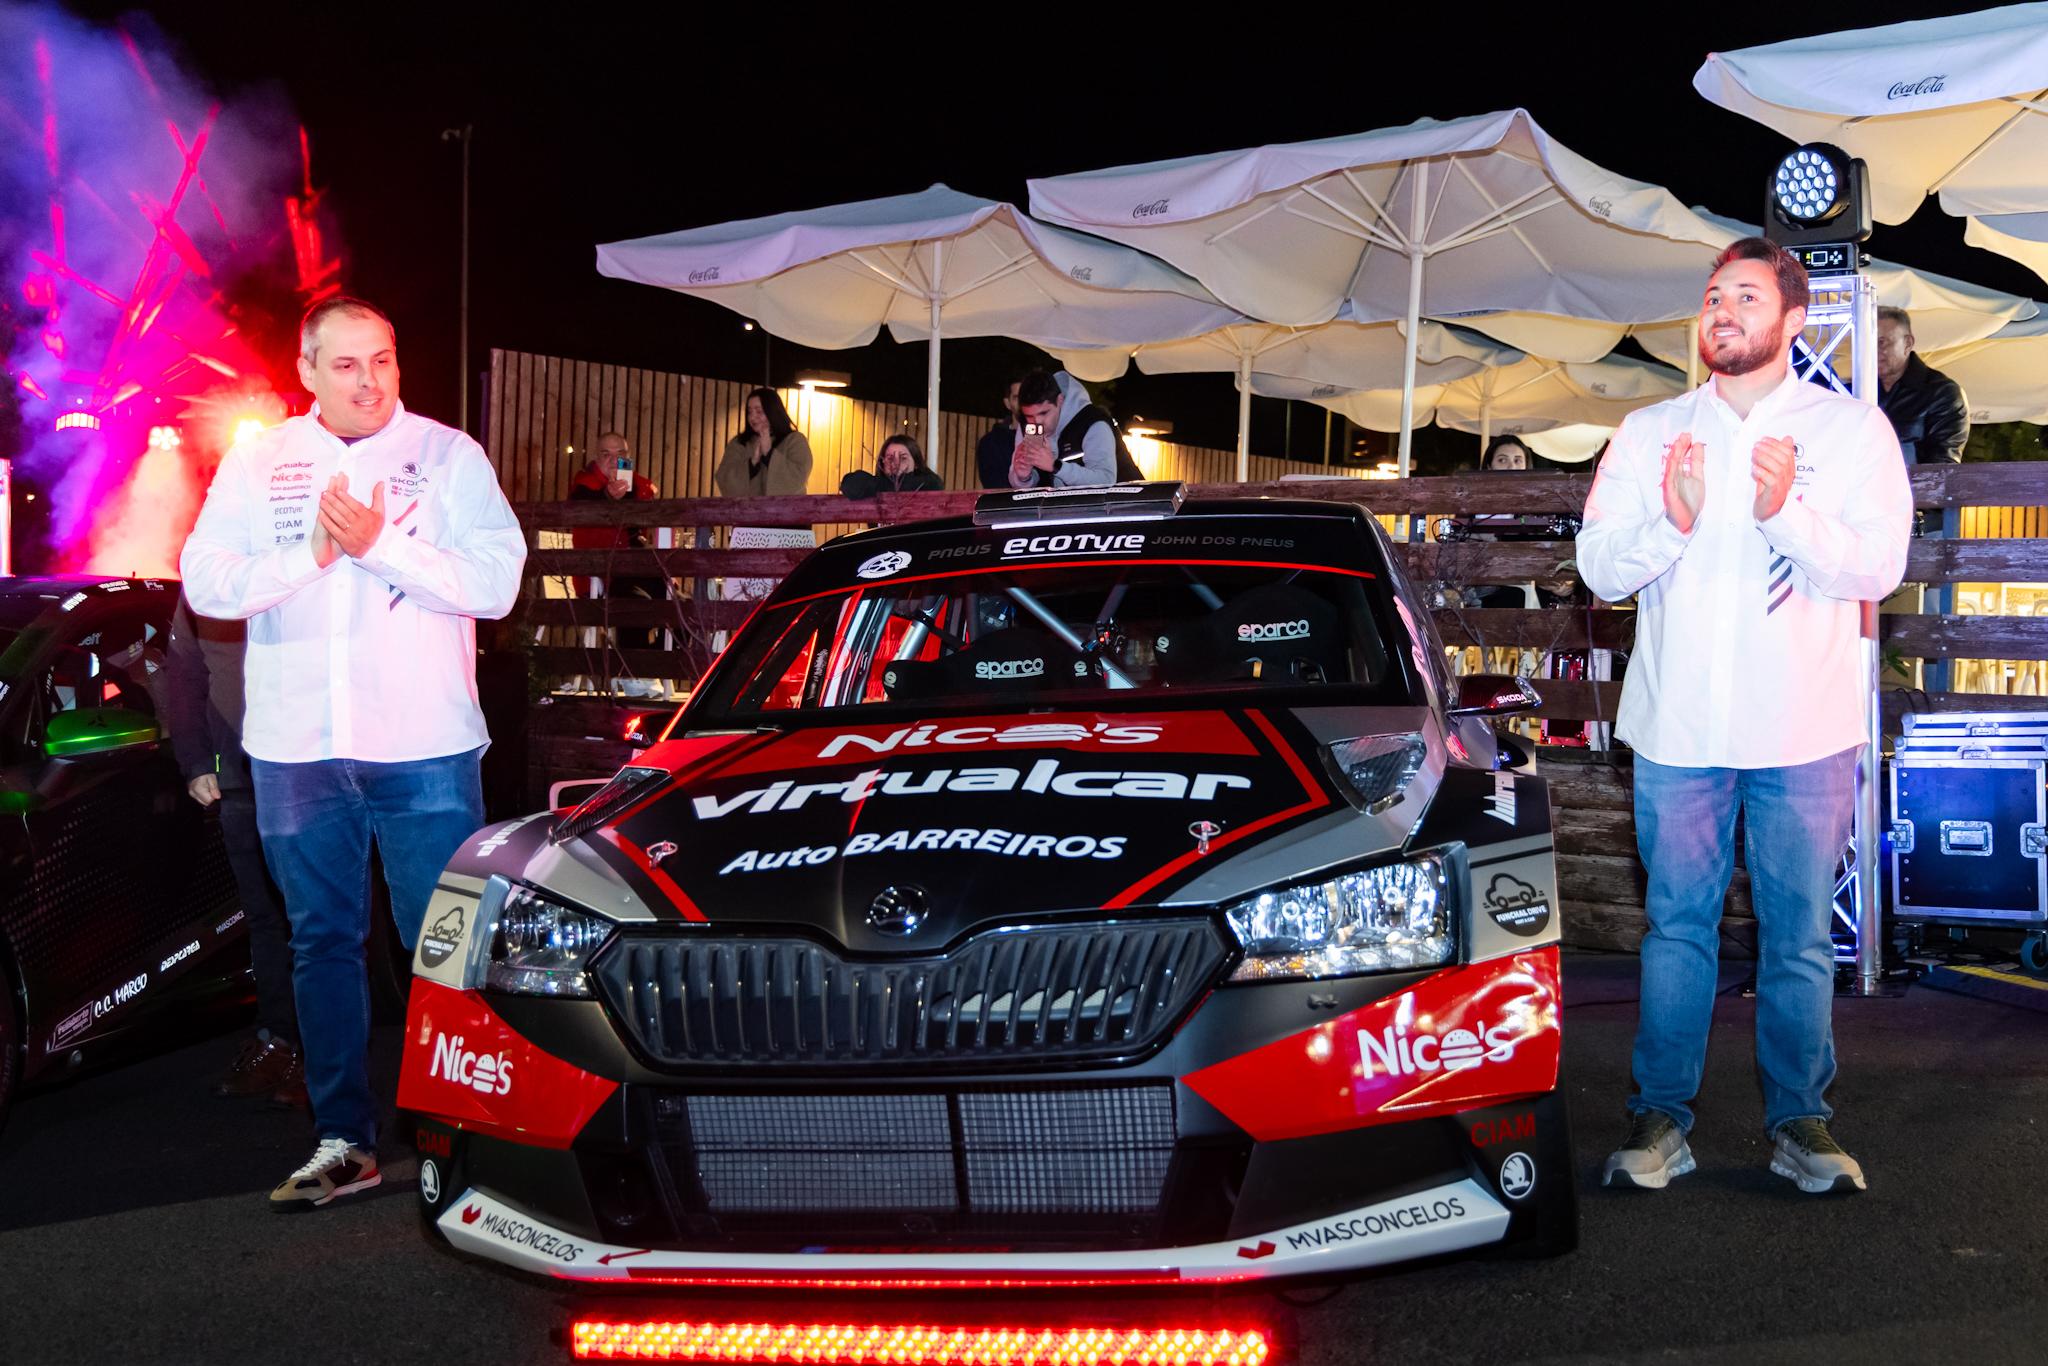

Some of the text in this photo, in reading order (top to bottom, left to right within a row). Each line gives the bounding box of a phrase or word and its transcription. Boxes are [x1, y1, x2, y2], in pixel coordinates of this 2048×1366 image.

[274, 519, 303, 530] CIAM
[1151, 535, 1197, 545] JOHN
[1202, 536, 1236, 546] DOS
[1241, 537, 1295, 548] PNEUS
[1238, 620, 1310, 643] sparco
[975, 657, 1044, 680] sparco
[692, 759, 1251, 820] virtualcar
[719, 828, 1128, 875] Auto BARREIROS
[115, 973, 147, 1005] MARCO
[1471, 1112, 1537, 1147] CIAM
[481, 1212, 584, 1263] MVASCONCELOS
[1286, 1197, 1465, 1250] MVASCONCELOS
